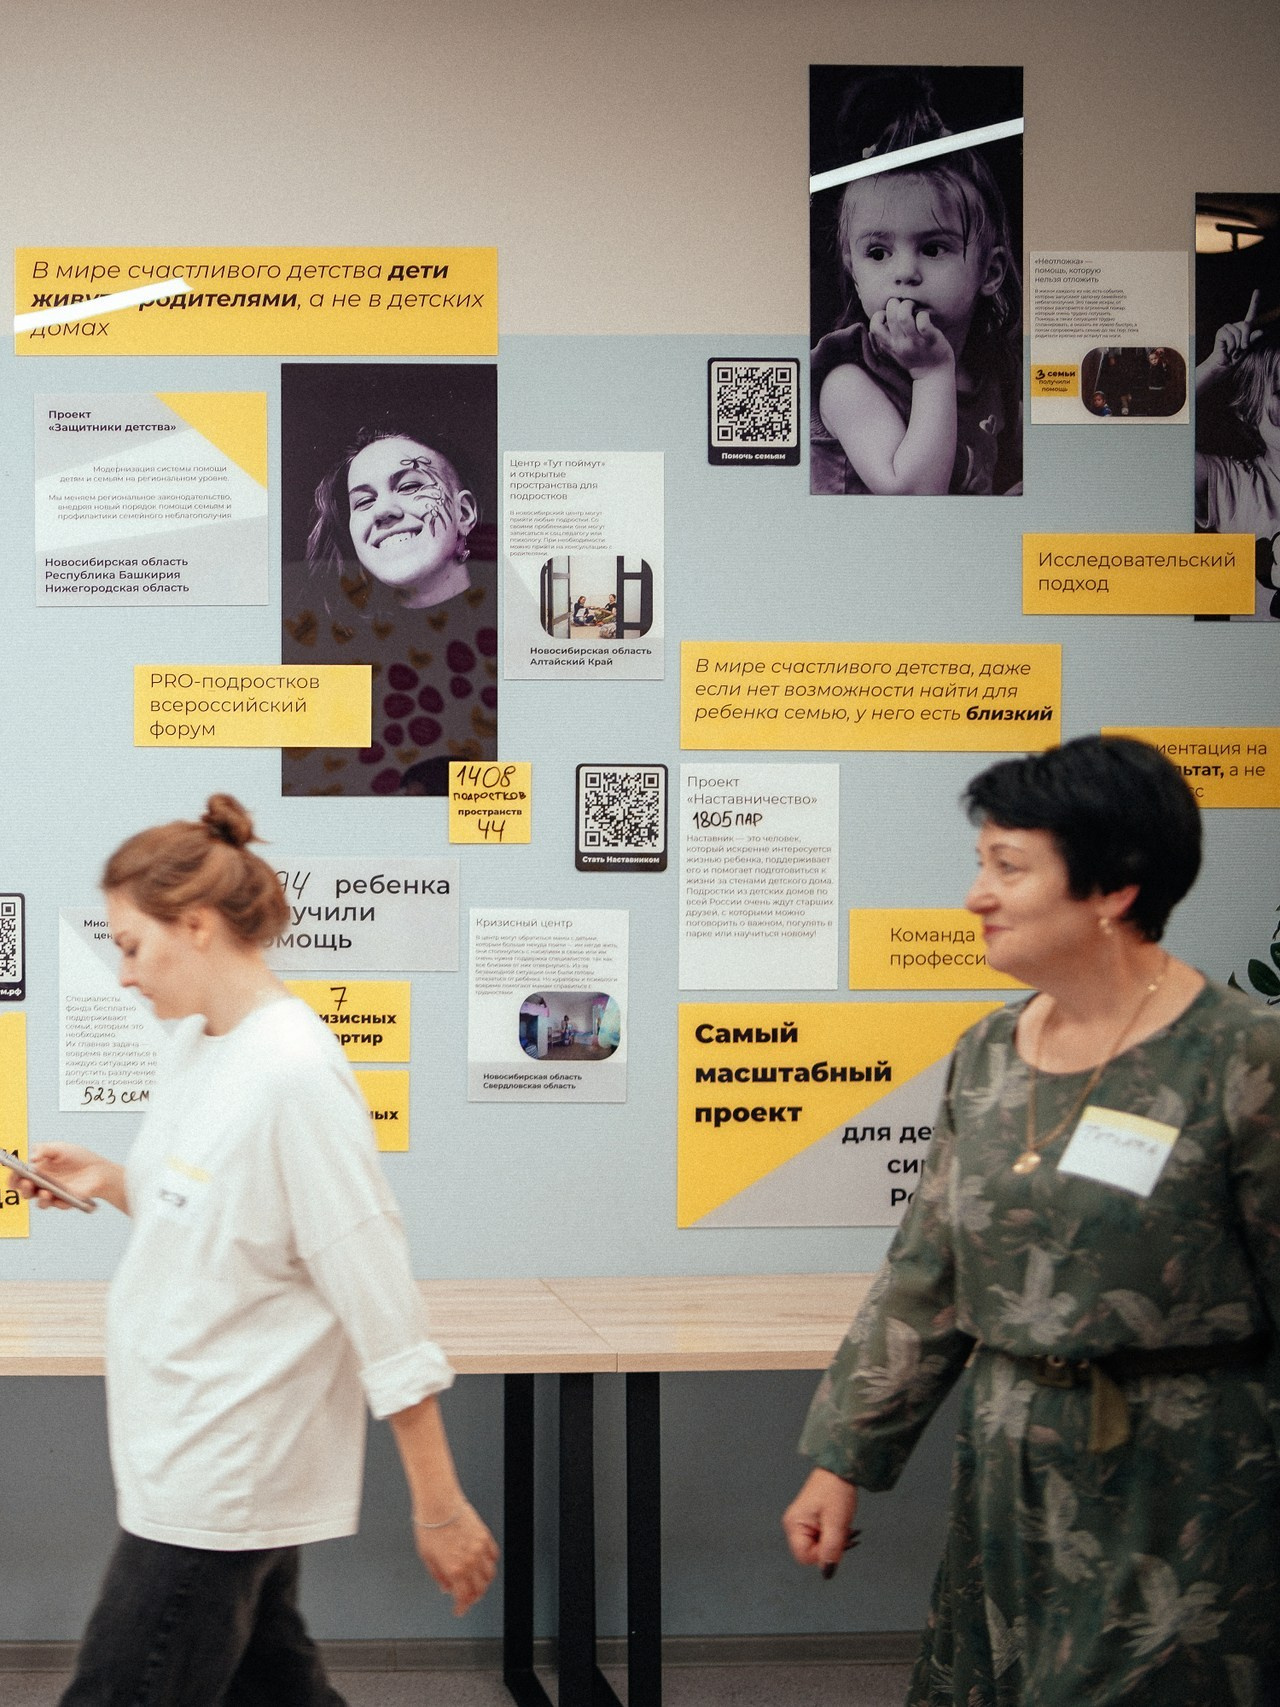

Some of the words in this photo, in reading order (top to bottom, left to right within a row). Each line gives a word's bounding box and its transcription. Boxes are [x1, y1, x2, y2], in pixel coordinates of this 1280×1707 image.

[32, 261, 48, 278] В
[56, 264, 120, 283] мире
[128, 264, 281, 278] счастливого
[285, 264, 382, 281] детства
[386, 264, 449, 281] дети
[309, 293, 324, 307] а
[332, 293, 361, 307] не
[368, 293, 381, 307] в
[386, 293, 484, 310] детских
[29, 322, 110, 339] домах
[48, 410, 91, 420] Проект
[48, 422, 121, 432] «Защитники
[124, 424, 176, 432] детства»
[510, 459, 541, 468] Центр
[542, 459, 562, 468] «Тут
[564, 459, 605, 468] поймут»
[518, 471, 566, 479] открытые
[509, 482, 577, 490] пространства
[509, 493, 567, 501] подростков
[45, 556, 138, 568] Новосибирская
[140, 556, 188, 566] область
[1039, 551, 1235, 569] Исследовательский
[45, 570, 115, 581] Республика
[119, 570, 180, 580] Башкирия
[45, 584, 139, 594] Нижегородская
[142, 582, 189, 592] область
[1038, 578, 1109, 593] подход
[530, 646, 609, 656] Новосибирская
[611, 646, 652, 654] область
[530, 657, 585, 665] Алтайский
[588, 657, 612, 667] Край
[695, 658, 709, 672] В
[714, 661, 765, 676] мире
[771, 661, 891, 674] счастливого
[895, 662, 974, 677] детства,
[978, 663, 1031, 677] даже
[150, 673, 319, 692] PRO-подростков
[695, 684, 741, 696] если
[746, 684, 780, 696] нет
[784, 685, 914, 697] возможности
[919, 682, 978, 698] найти
[981, 686, 1018, 700] для
[150, 696, 306, 715] всероссийский
[694, 703, 778, 721] ребенка
[784, 708, 849, 721] семью,
[854, 709, 866, 723] у
[871, 708, 914, 720] него
[920, 709, 960, 720] есть
[966, 705, 1053, 721] близкий
[149, 720, 214, 739] форум
[1156, 744, 1240, 758] иентация
[1246, 744, 1267, 755] на
[456, 764, 516, 788] 1408
[687, 775, 739, 789] Проект
[452, 791, 526, 803] подростков
[687, 793, 817, 804] «Наставничество»
[458, 809, 522, 817] пространств
[692, 810, 732, 829] 1805
[476, 819, 506, 843] 44
[582, 855, 605, 863] Стать
[607, 855, 660, 863] Наставником
[335, 874, 449, 898] ребенка
[291, 906, 374, 925] учили
[476, 918, 537, 928] Кризисный
[540, 920, 573, 929] центр
[890, 927, 975, 944] Команда
[890, 950, 988, 969] професси
[330, 986, 347, 1011] 7
[318, 1014, 396, 1023] изисных
[694, 1021, 798, 1043] Самый
[483, 1073, 547, 1081] Новосибирская
[695, 1060, 891, 1083] масштабный
[482, 1082, 541, 1090] Свердловская
[695, 1106, 802, 1127] проект
[841, 1126, 890, 1144] для
